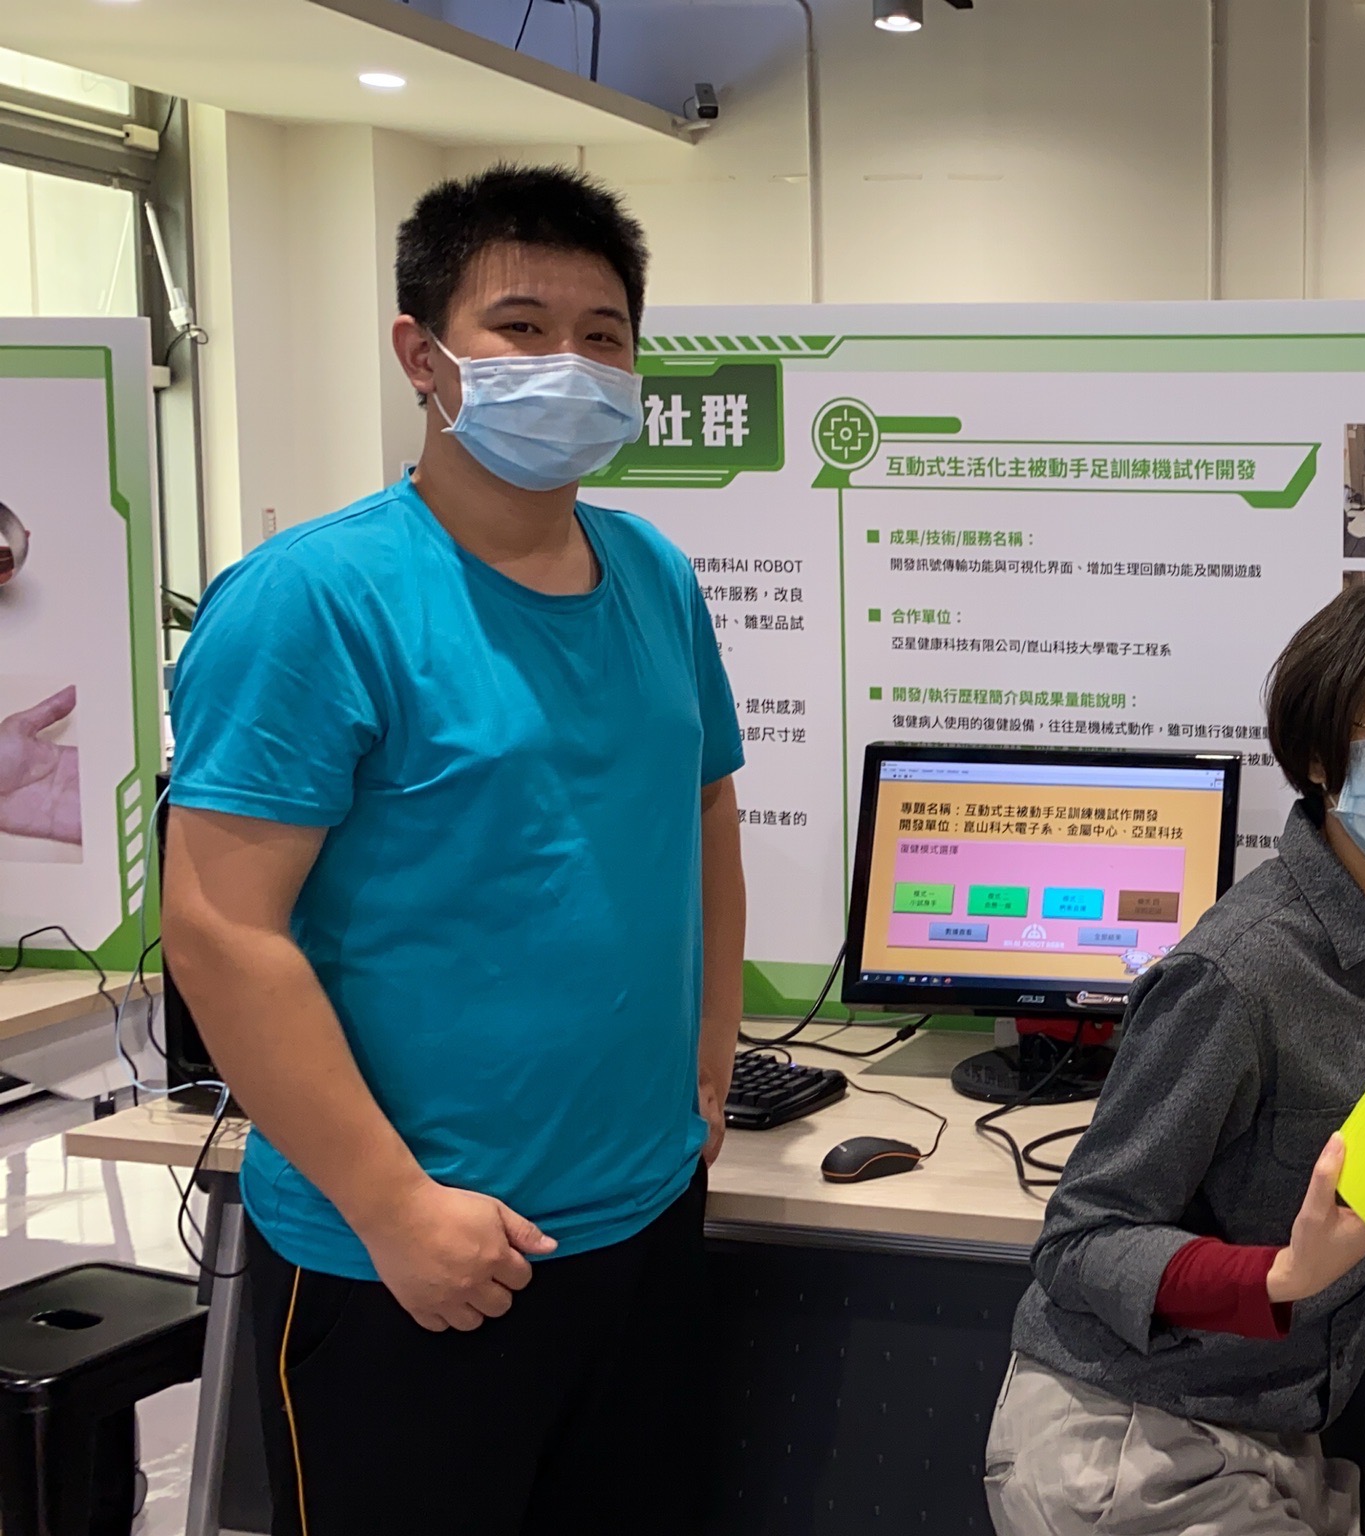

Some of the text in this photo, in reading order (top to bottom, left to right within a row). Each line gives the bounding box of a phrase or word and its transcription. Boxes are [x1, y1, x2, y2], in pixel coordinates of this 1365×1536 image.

[644, 394, 749, 447] 社群
[886, 456, 1257, 481] 互動式生活化主被動手足訓練機試作開發
[890, 529, 1034, 547] 成果/技術/服務名稱：
[688, 556, 803, 574] 用南科AI ROBOT
[708, 614, 805, 631] 計、雛型品試
[891, 608, 963, 625] 合作單位：
[891, 636, 1172, 658] 亞星健康科技有限公司/崑山科技大學電子工程系
[892, 687, 1137, 709] 開發/執行歷程簡介與成果量能說明：
[900, 802, 1158, 822] 專題名稱：互動式主被動手足訓練機試作開發
[899, 819, 1184, 840] 開發單位：崑山科大電子系、金屬中心、亞星科技
[1017, 994, 1045, 1004] ASUS
